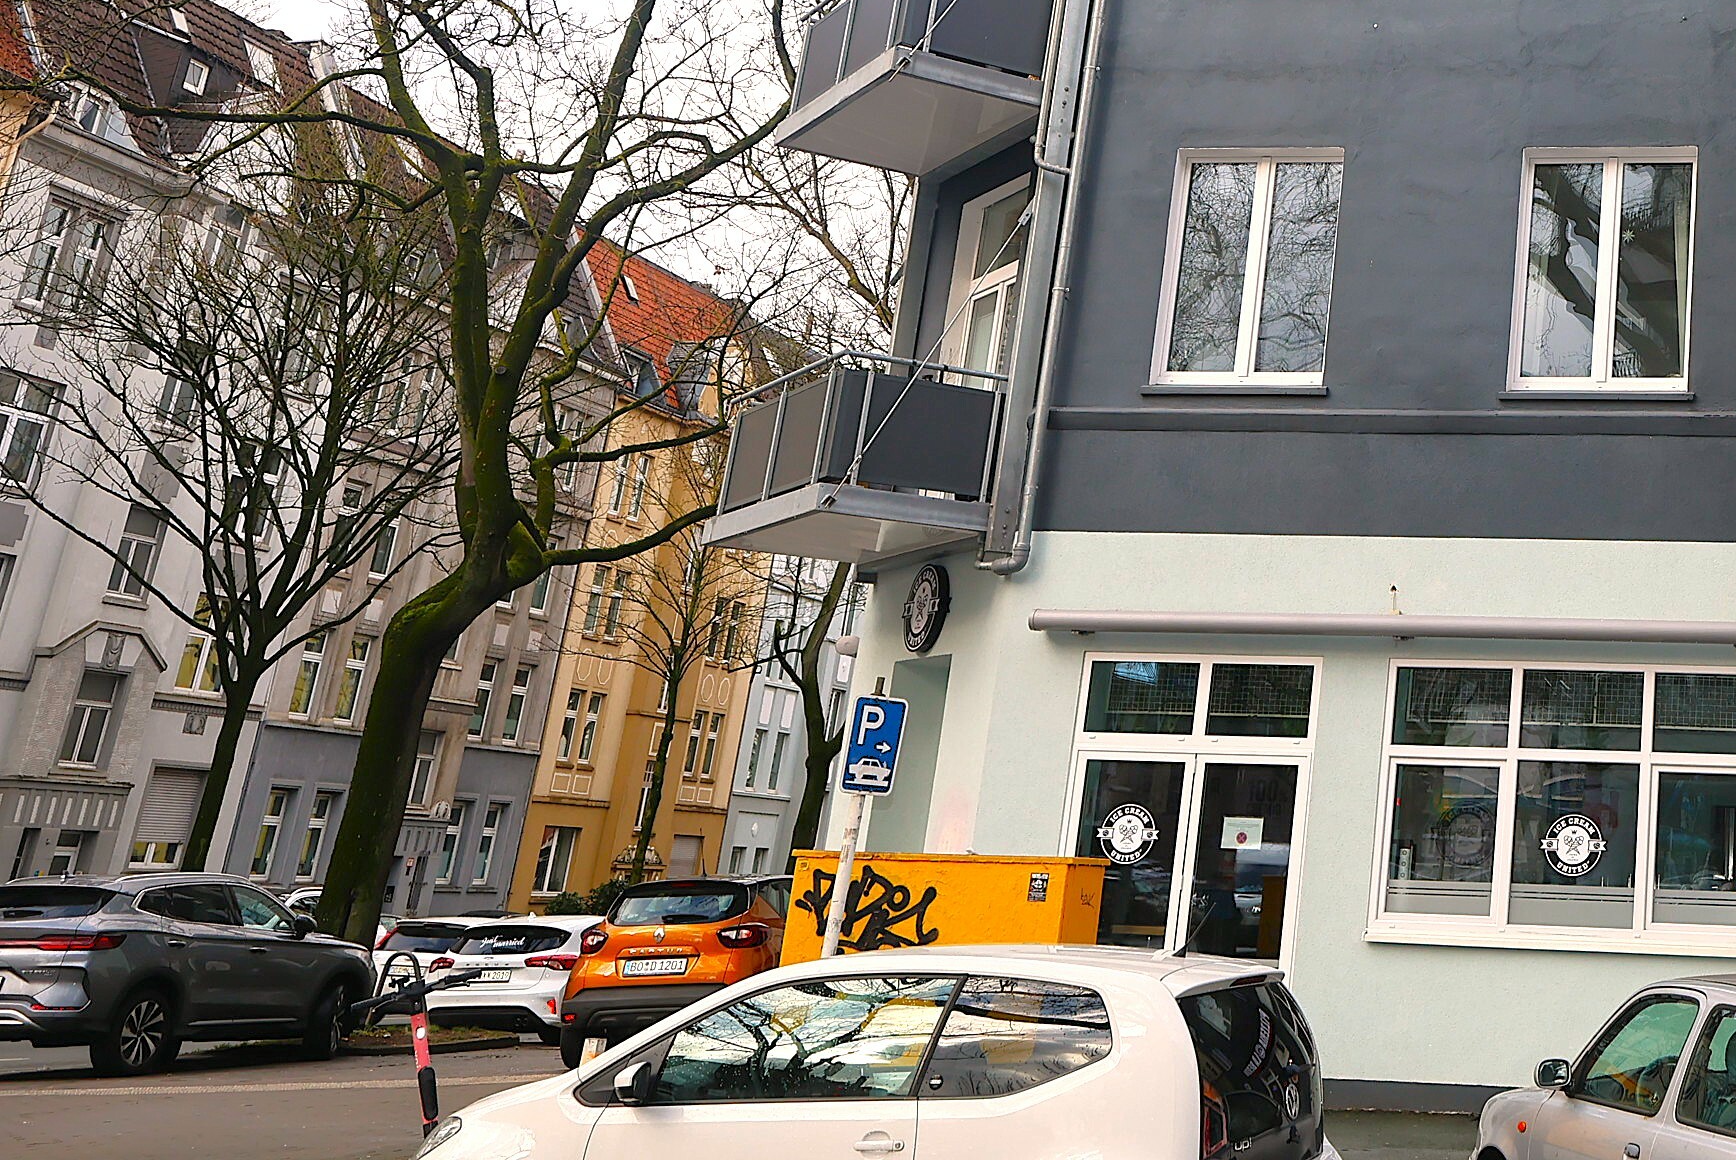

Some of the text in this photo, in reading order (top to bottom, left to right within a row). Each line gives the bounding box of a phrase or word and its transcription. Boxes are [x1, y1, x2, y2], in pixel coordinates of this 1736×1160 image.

[857, 704, 885, 746] P
[1109, 807, 1150, 824] ICE CREAM
[1552, 818, 1596, 835] ICE CREAM
[1110, 849, 1141, 861] UNITED
[1556, 861, 1589, 874] UNITED
[658, 960, 684, 971] 1201
[1234, 1137, 1252, 1151] up!
